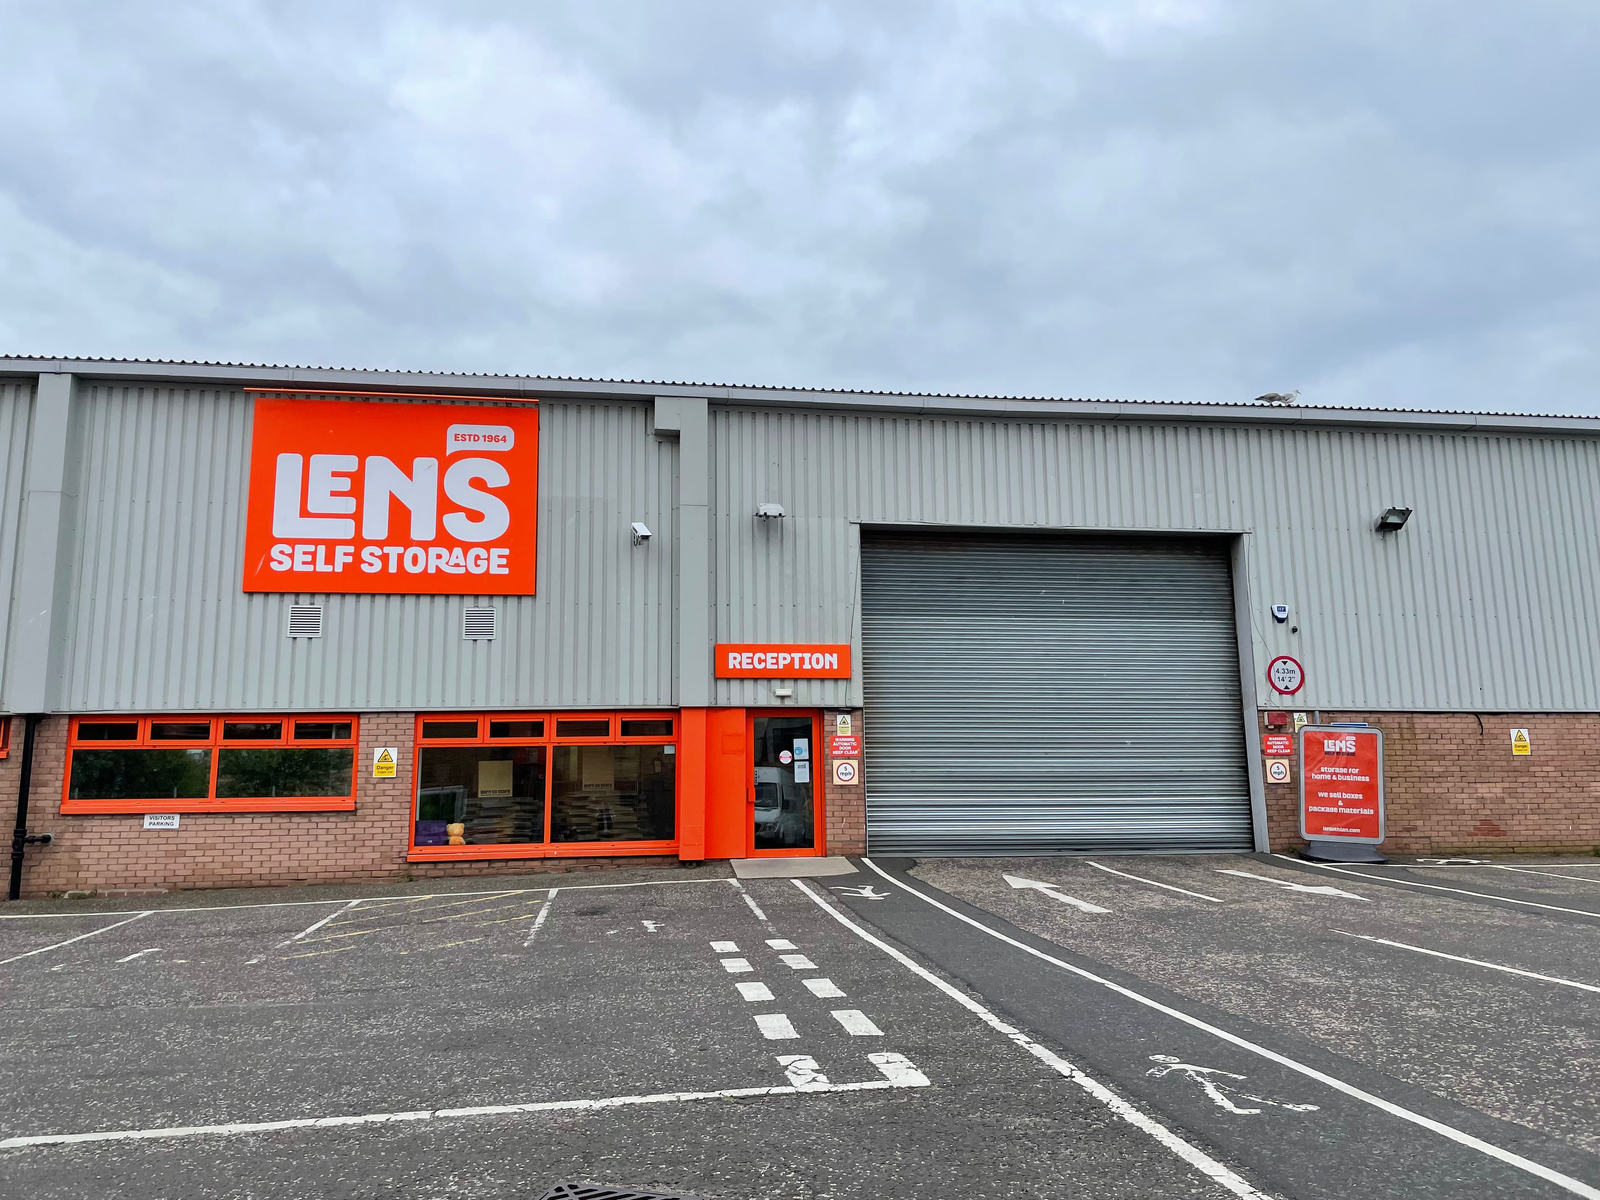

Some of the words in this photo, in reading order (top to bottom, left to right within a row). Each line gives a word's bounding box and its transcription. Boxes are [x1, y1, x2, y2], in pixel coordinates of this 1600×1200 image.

[454, 433, 480, 443] ESTD
[482, 434, 507, 444] 1964
[270, 544, 354, 572] SELF
[360, 546, 510, 574] STORAGE
[728, 652, 837, 670] RECEPTION
